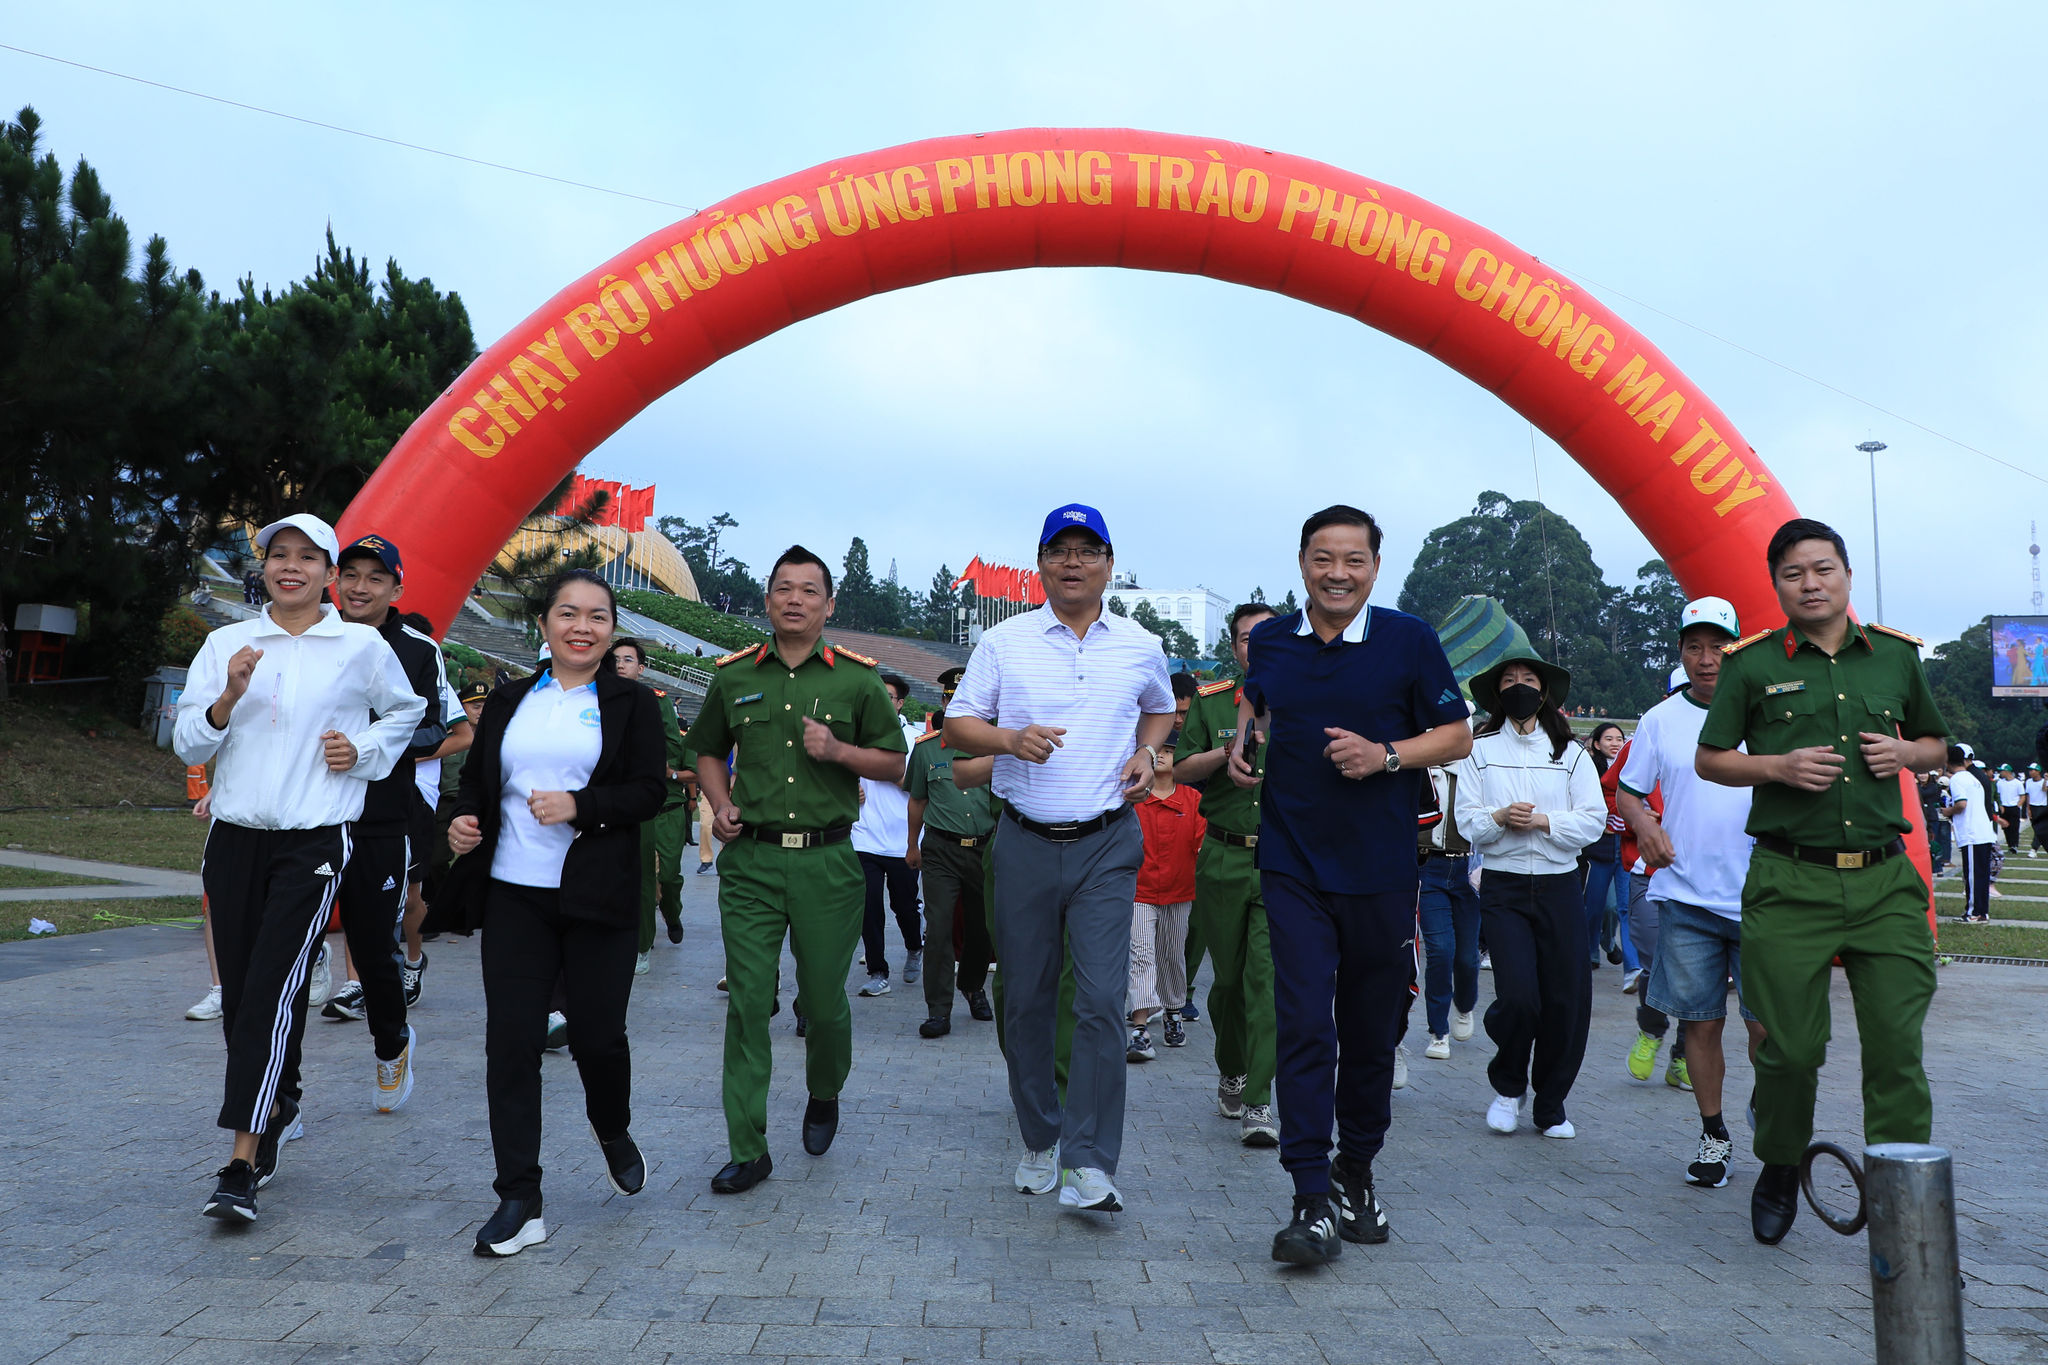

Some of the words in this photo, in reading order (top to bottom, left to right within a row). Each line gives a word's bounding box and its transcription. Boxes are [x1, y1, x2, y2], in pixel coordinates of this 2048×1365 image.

[449, 327, 581, 459] CHẠY
[563, 273, 654, 361] BỘ
[635, 195, 821, 312] HƯỞNG
[816, 169, 934, 237] ỨNG
[936, 150, 1113, 214] PHONG
[1128, 150, 1270, 223] TRÀO
[1278, 179, 1451, 286] PHÒNG
[1454, 248, 1616, 381] CHỐNG
[1603, 353, 1686, 443] MA
[1670, 417, 1771, 518] TUÝ
